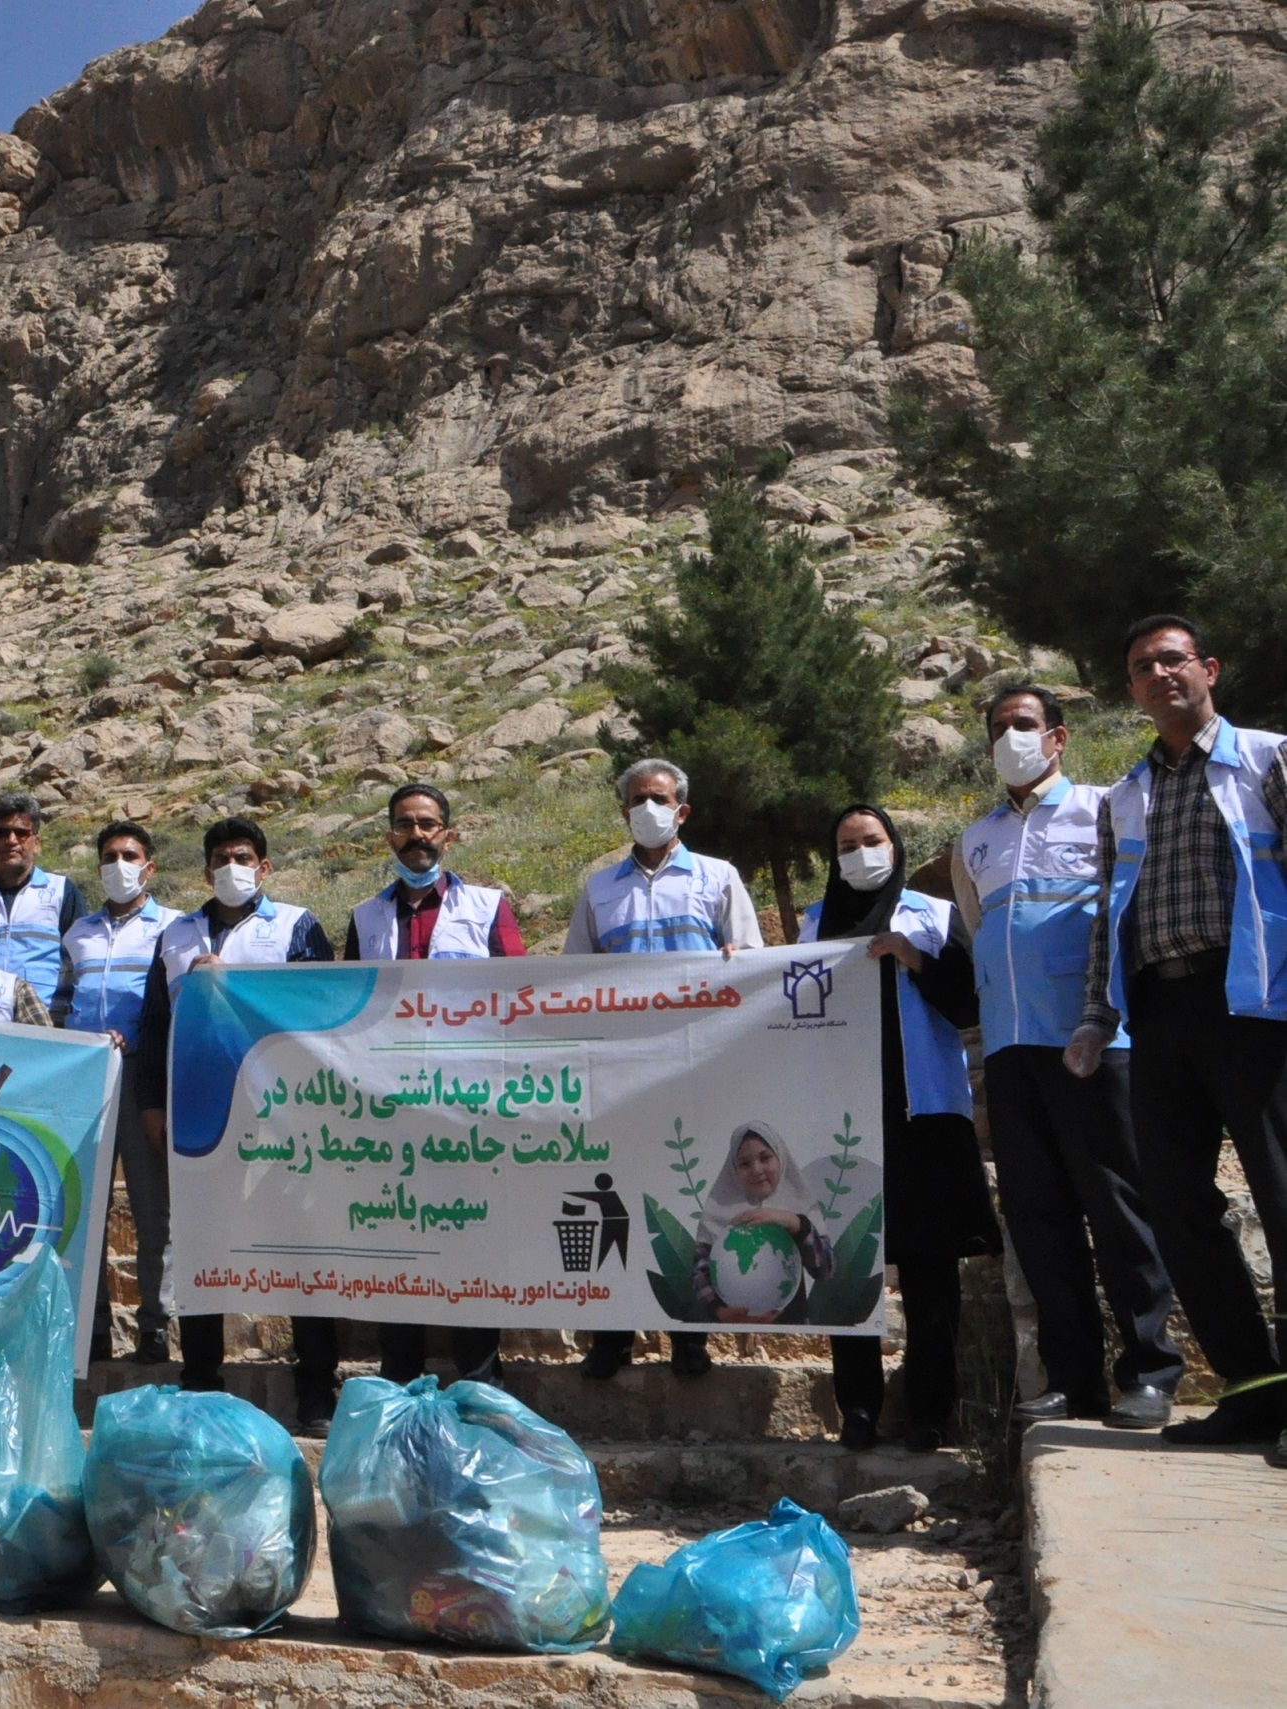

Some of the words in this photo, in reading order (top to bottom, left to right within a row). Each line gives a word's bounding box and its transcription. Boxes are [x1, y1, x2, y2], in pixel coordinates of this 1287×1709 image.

[395, 992, 438, 1027] باد
[442, 984, 535, 1026] گرامی
[539, 987, 648, 1015] سلامت
[652, 981, 743, 1011] هفته
[257, 1076, 289, 1119] در
[369, 1068, 491, 1119] بهداشتی
[496, 1063, 555, 1118] دفع
[561, 1065, 582, 1115] با
[237, 1131, 313, 1174] زیست
[318, 1123, 393, 1173] محیط
[399, 1139, 415, 1176] و
[420, 1124, 506, 1175] جامعه
[512, 1122, 611, 1164] سلامت
[349, 1182, 416, 1232] باشیم
[420, 1198, 488, 1234] سهیم
[194, 1267, 258, 1293] کرمانشاه
[258, 1269, 301, 1293] استان
[302, 1270, 352, 1300] پزشکی
[353, 1274, 386, 1299] علوم
[387, 1272, 446, 1297] دانشگاه
[446, 1277, 517, 1305] بهداشتی
[518, 1280, 551, 1306] امور
[552, 1279, 610, 1306] معاونت
